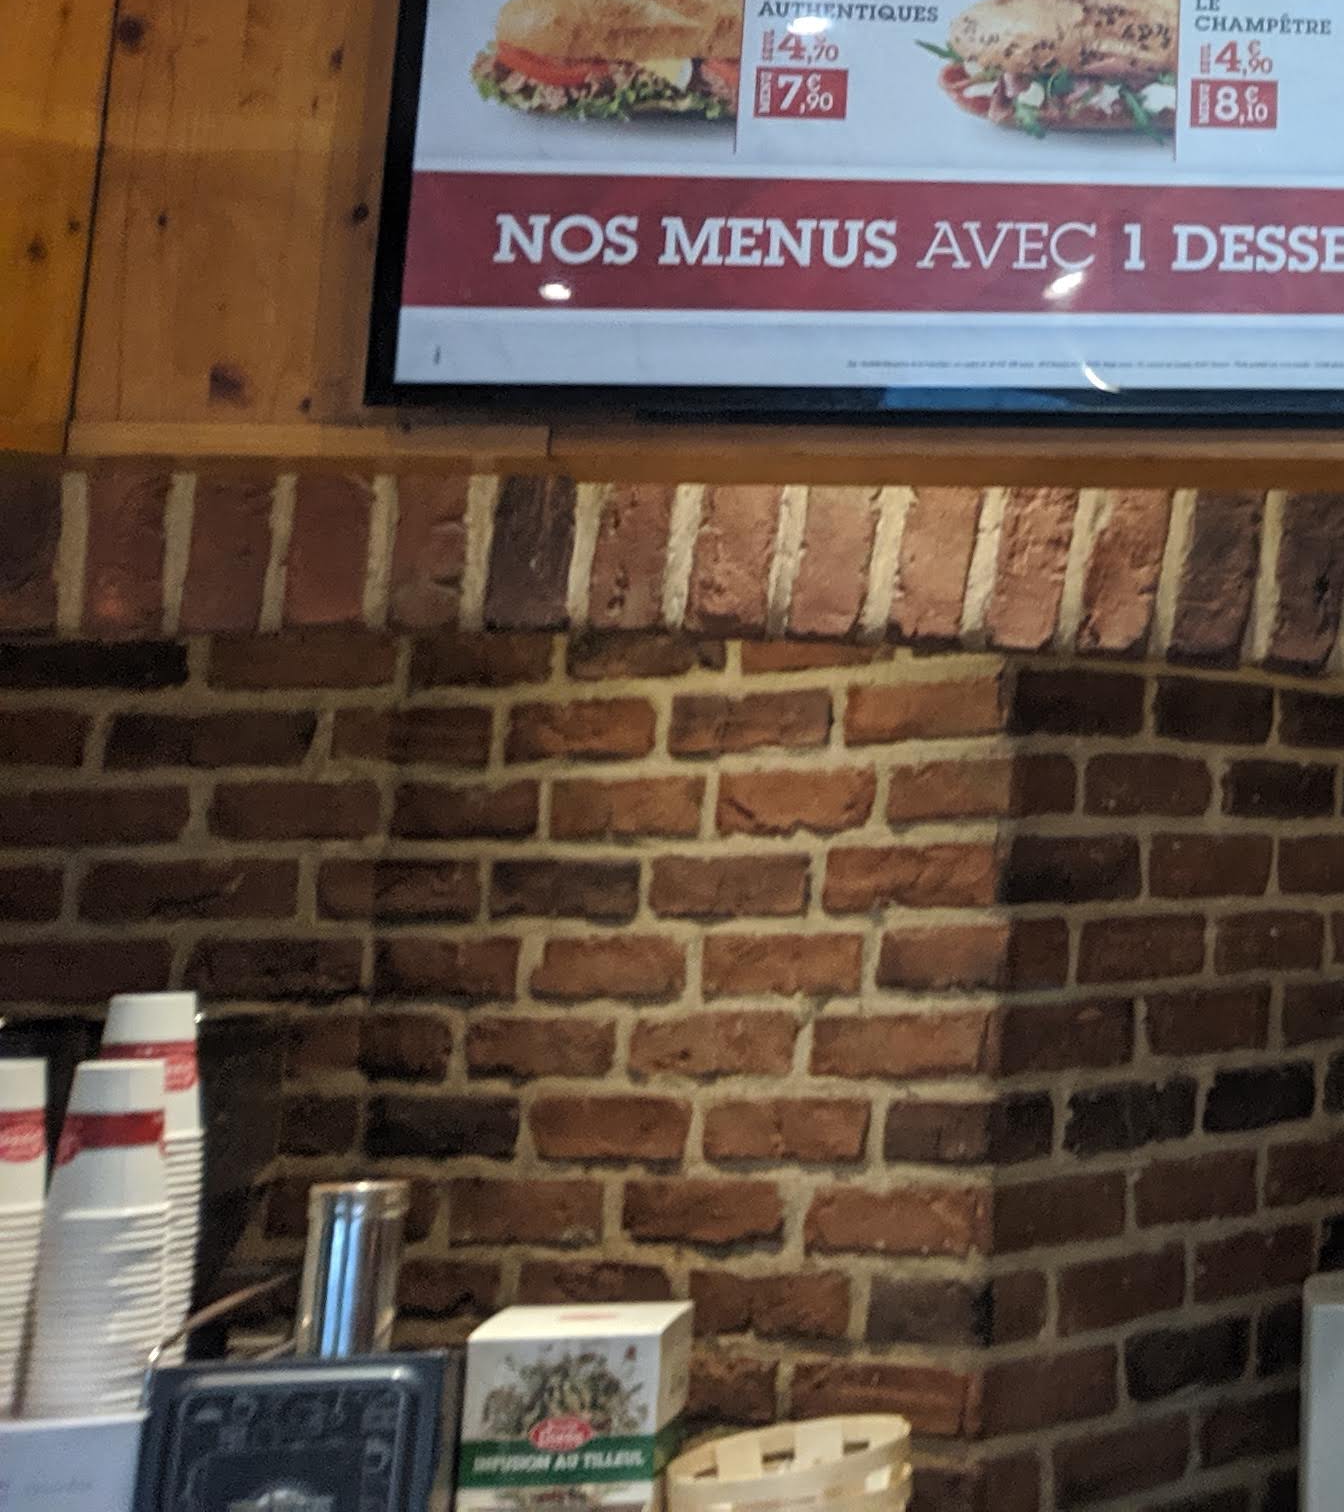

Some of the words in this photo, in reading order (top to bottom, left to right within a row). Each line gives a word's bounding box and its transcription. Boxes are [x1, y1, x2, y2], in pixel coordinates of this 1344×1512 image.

[759, 1, 938, 22] AUTHENTIQUES
[1195, 13, 1332, 35] CHAMPÊTRE
[493, 213, 639, 266] NOS
[658, 216, 898, 269] MENUS
[916, 221, 1096, 271] AVEC
[1123, 223, 1144, 271] 1
[554, 1453, 580, 1472] AU
